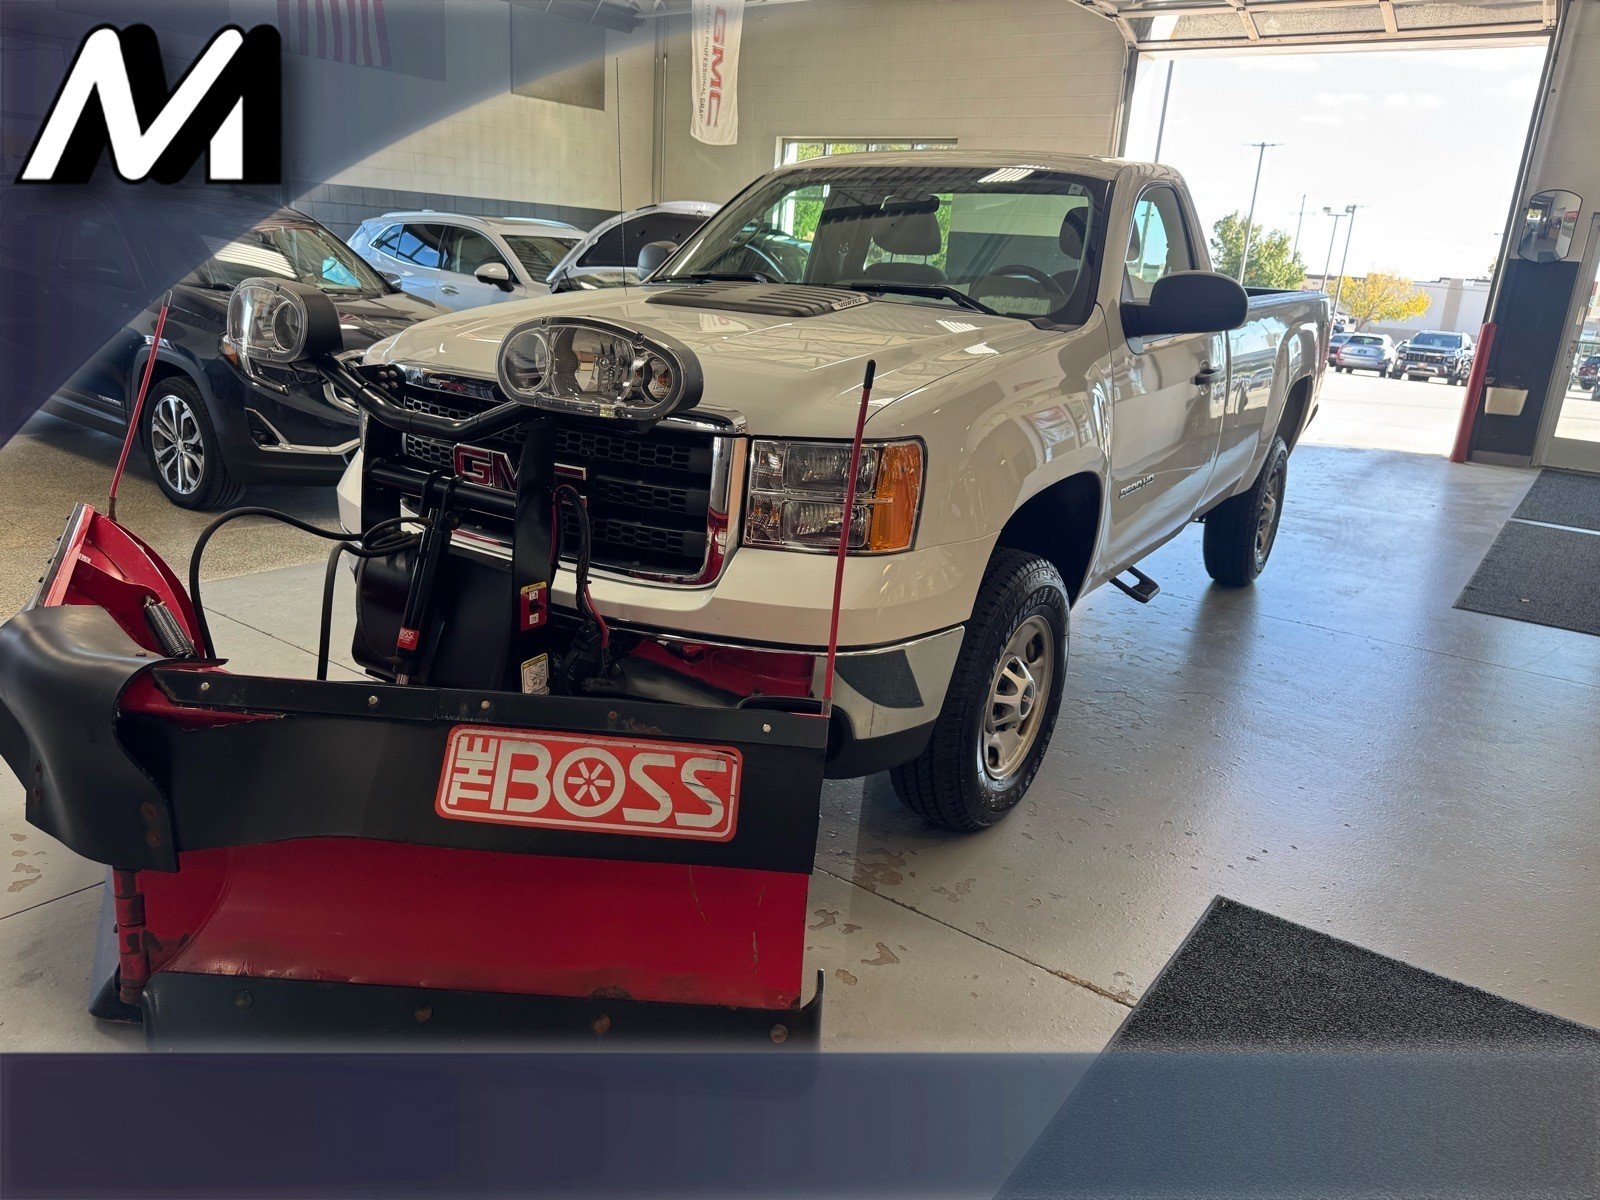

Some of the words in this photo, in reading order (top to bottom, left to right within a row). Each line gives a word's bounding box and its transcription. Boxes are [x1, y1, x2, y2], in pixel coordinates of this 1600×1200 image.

[700, 36, 709, 96] PROFESSIONAL
[707, 6, 725, 127] GMC
[837, 297, 863, 307] VORTEC
[448, 737, 498, 805] THE
[490, 740, 727, 828] BOSS
